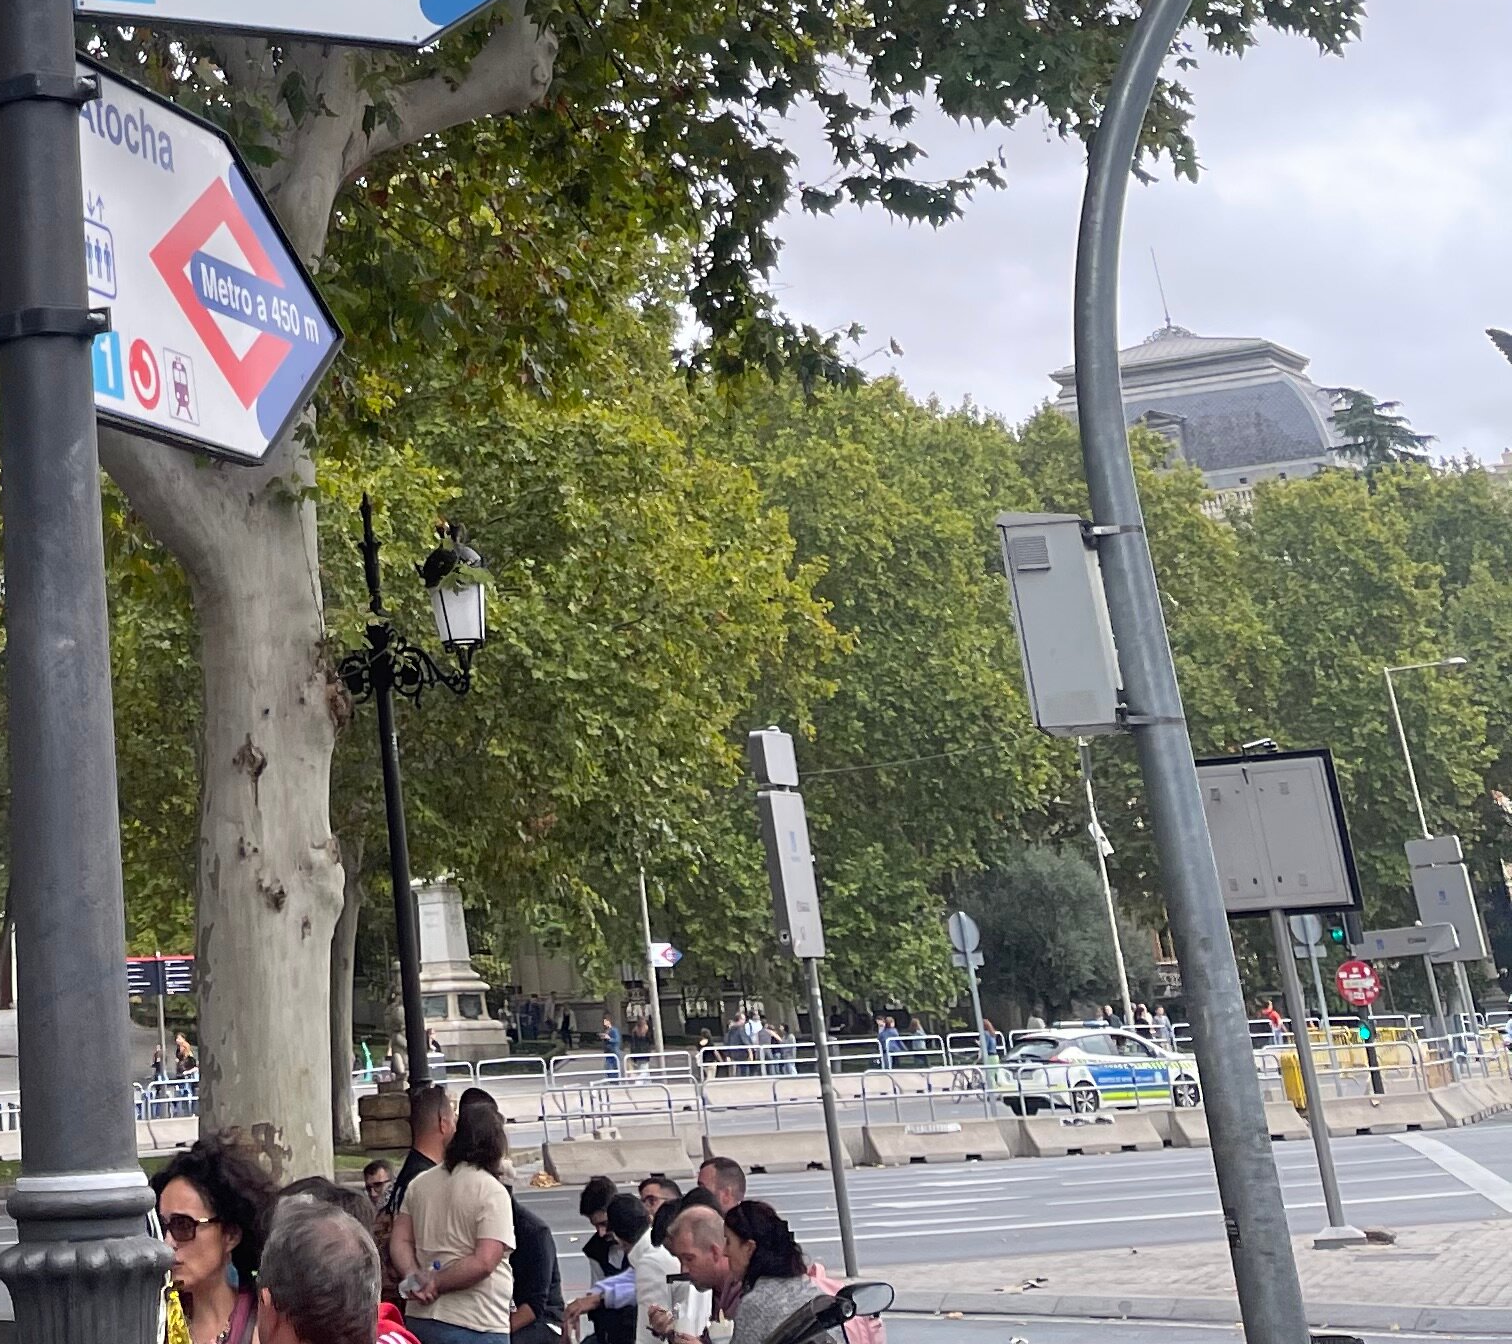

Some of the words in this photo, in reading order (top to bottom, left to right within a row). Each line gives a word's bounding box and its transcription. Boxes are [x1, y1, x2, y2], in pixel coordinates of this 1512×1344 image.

[200, 262, 253, 316] Metro
[256, 294, 268, 323] a
[271, 296, 300, 337] 450
[303, 315, 320, 345] m
[99, 334, 115, 390] 1
